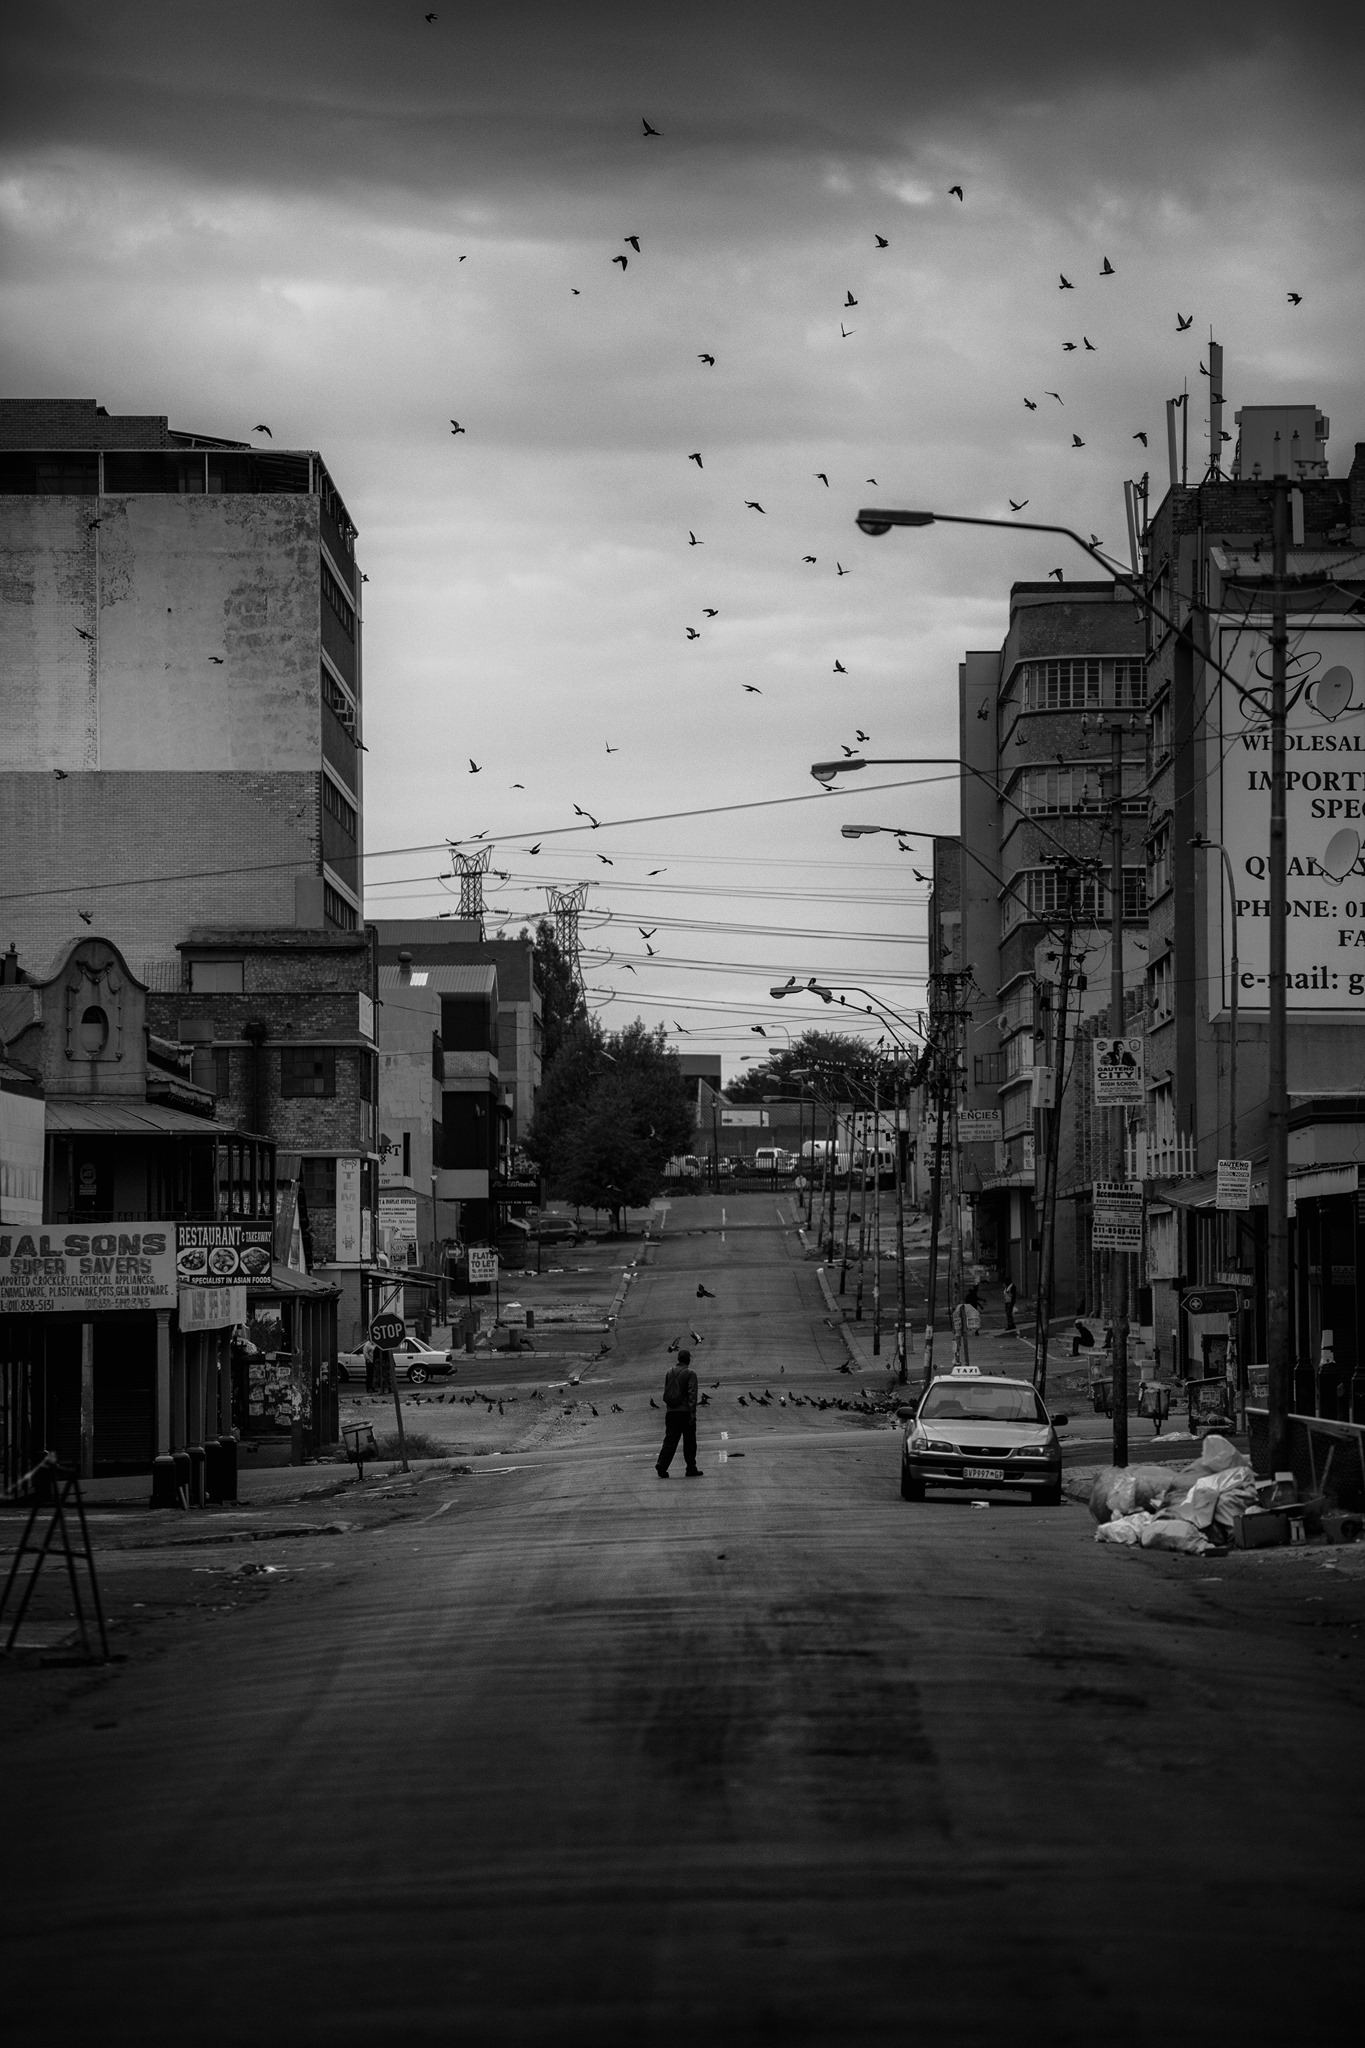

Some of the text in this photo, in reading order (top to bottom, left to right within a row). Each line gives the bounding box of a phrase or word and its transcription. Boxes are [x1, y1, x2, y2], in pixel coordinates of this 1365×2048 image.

[1096, 1183, 1134, 1191] STUDENT
[179, 1226, 241, 1246] RESTAURANT
[246, 1231, 272, 1242] TAKEAWAY
[10, 1257, 152, 1276] SUPER SAVERS
[471, 1260, 496, 1268] TO LET
[191, 1276, 225, 1285] SPECIALIST
[226, 1276, 233, 1284] IN
[233, 1276, 251, 1284] ASIAN
[252, 1276, 271, 1284] FOODS
[373, 1323, 403, 1341] STOP
